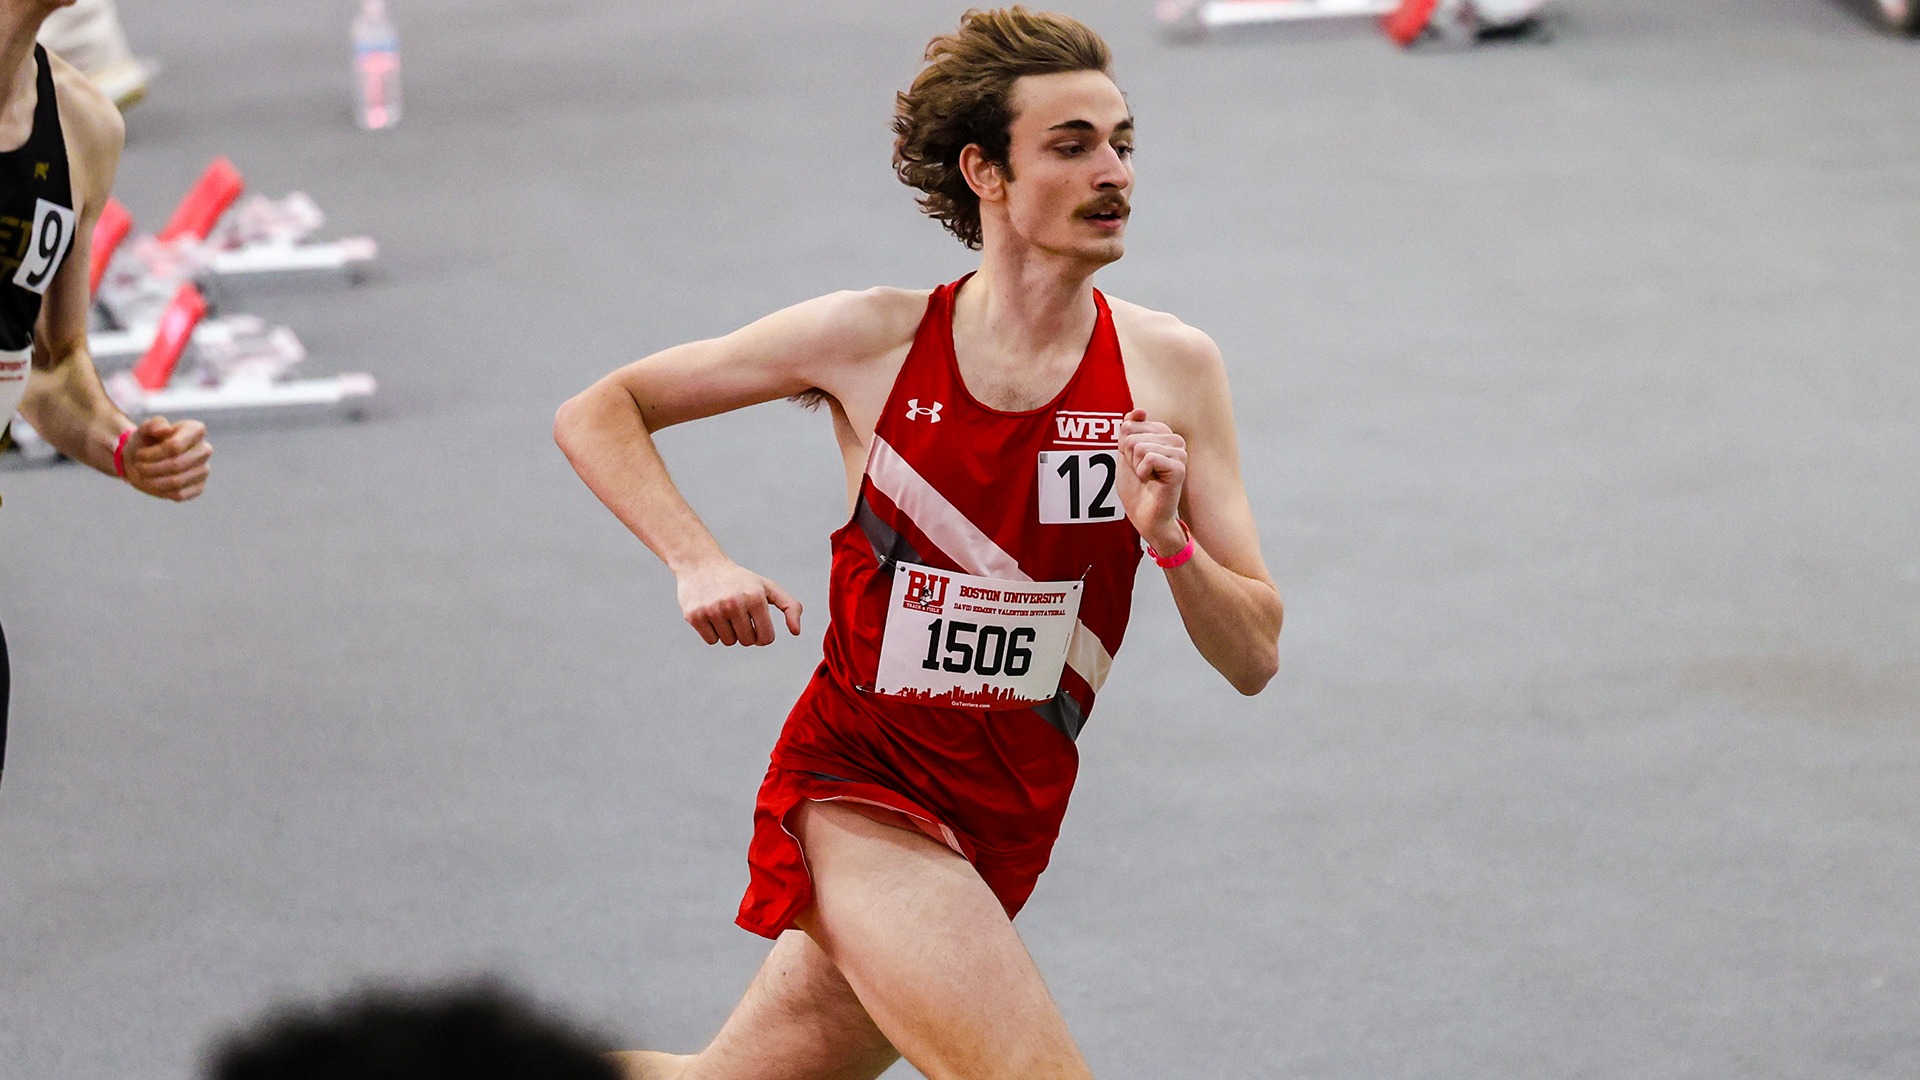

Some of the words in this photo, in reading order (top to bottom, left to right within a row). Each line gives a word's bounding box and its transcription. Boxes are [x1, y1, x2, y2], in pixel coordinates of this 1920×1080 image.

[26, 210, 63, 287] 9
[1055, 416, 1124, 440] WPI
[1056, 453, 1117, 520] 12
[904, 570, 951, 607] BU
[959, 585, 1002, 602] BOSTON
[1003, 591, 1067, 604] UNIVERSITY
[953, 602, 973, 612] DAVID
[998, 608, 1029, 617] VALENTINE
[922, 618, 1037, 676] 1506
